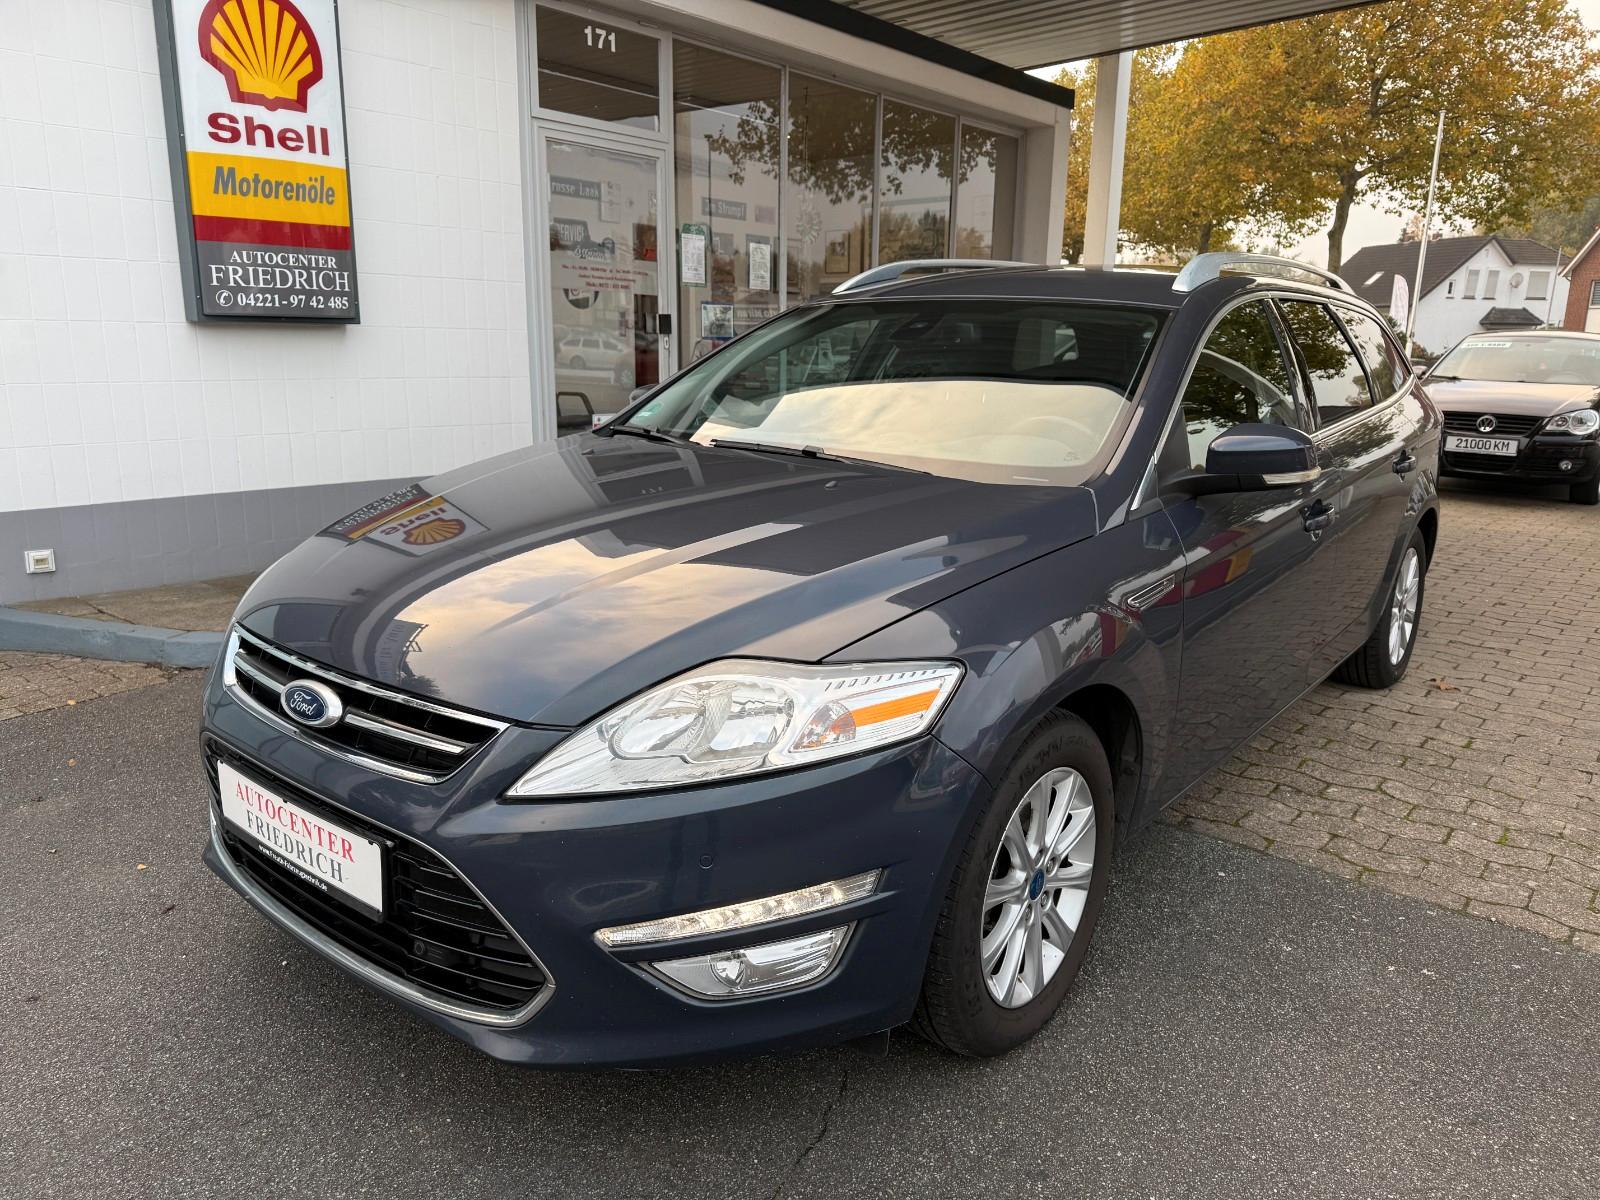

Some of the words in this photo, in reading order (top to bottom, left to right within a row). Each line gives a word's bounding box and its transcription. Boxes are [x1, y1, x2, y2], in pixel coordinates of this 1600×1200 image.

[584, 25, 616, 53] 171
[207, 112, 330, 156] Shell
[213, 165, 336, 205] Motorenöle
[230, 250, 338, 269] AUTOCENTER
[208, 264, 351, 292] FRIEDRICH
[309, 295, 325, 309] 42
[327, 295, 349, 310] 485
[1455, 438, 1492, 450] 21000
[1493, 440, 1510, 452] KM
[290, 691, 316, 716] Ford
[235, 778, 356, 864] AUTOCENTER
[246, 809, 344, 884] FRIEDRICH
